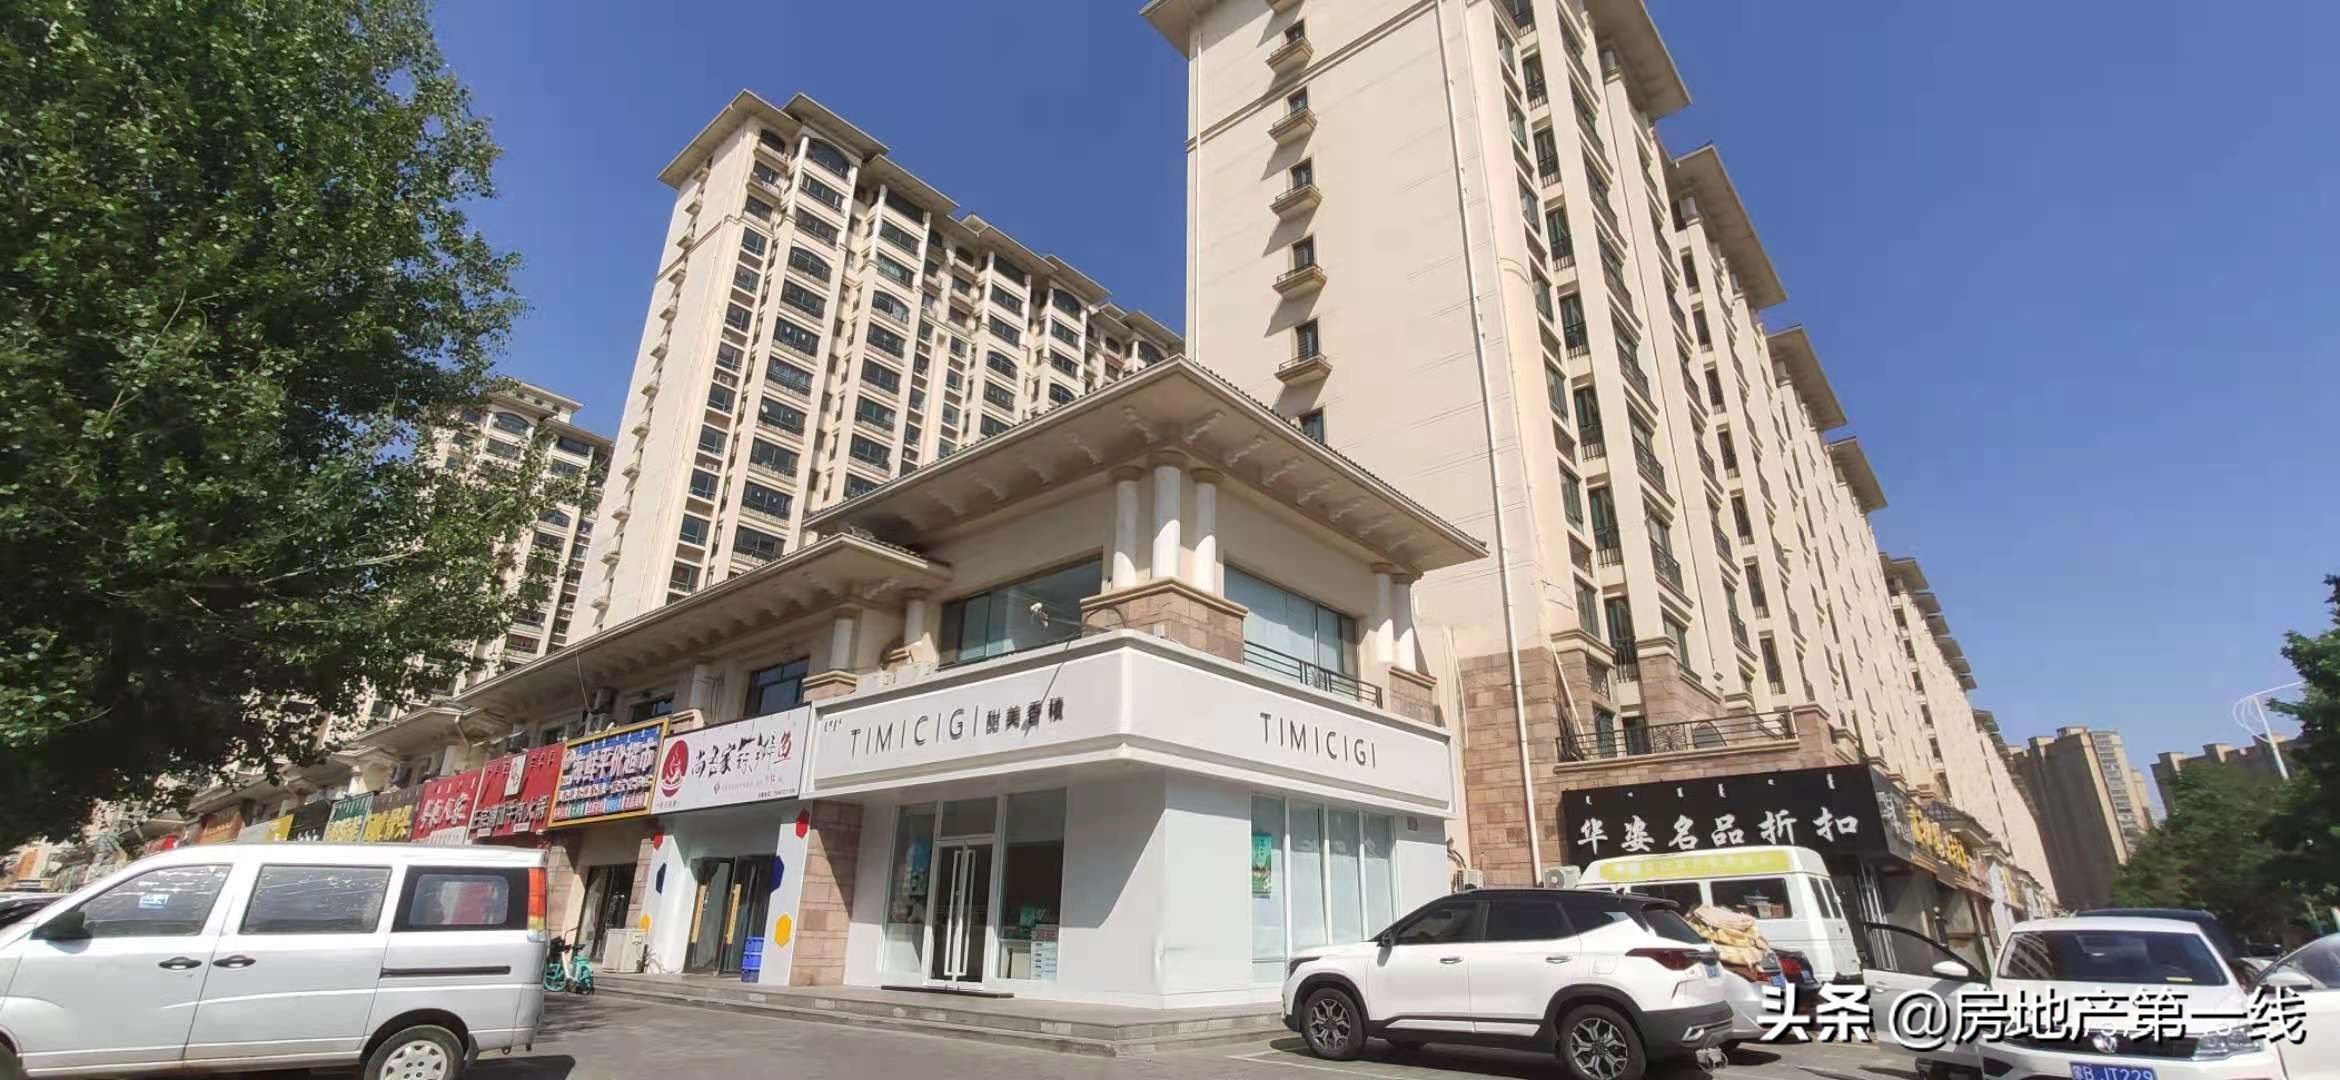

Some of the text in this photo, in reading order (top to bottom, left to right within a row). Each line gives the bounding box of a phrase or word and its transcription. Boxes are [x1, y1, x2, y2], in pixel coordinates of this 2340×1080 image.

[850, 704, 979, 758] TIMICIGI
[1259, 712, 1376, 768] TIMICIGI
[1577, 806, 1858, 854] 华姿名品折扣
